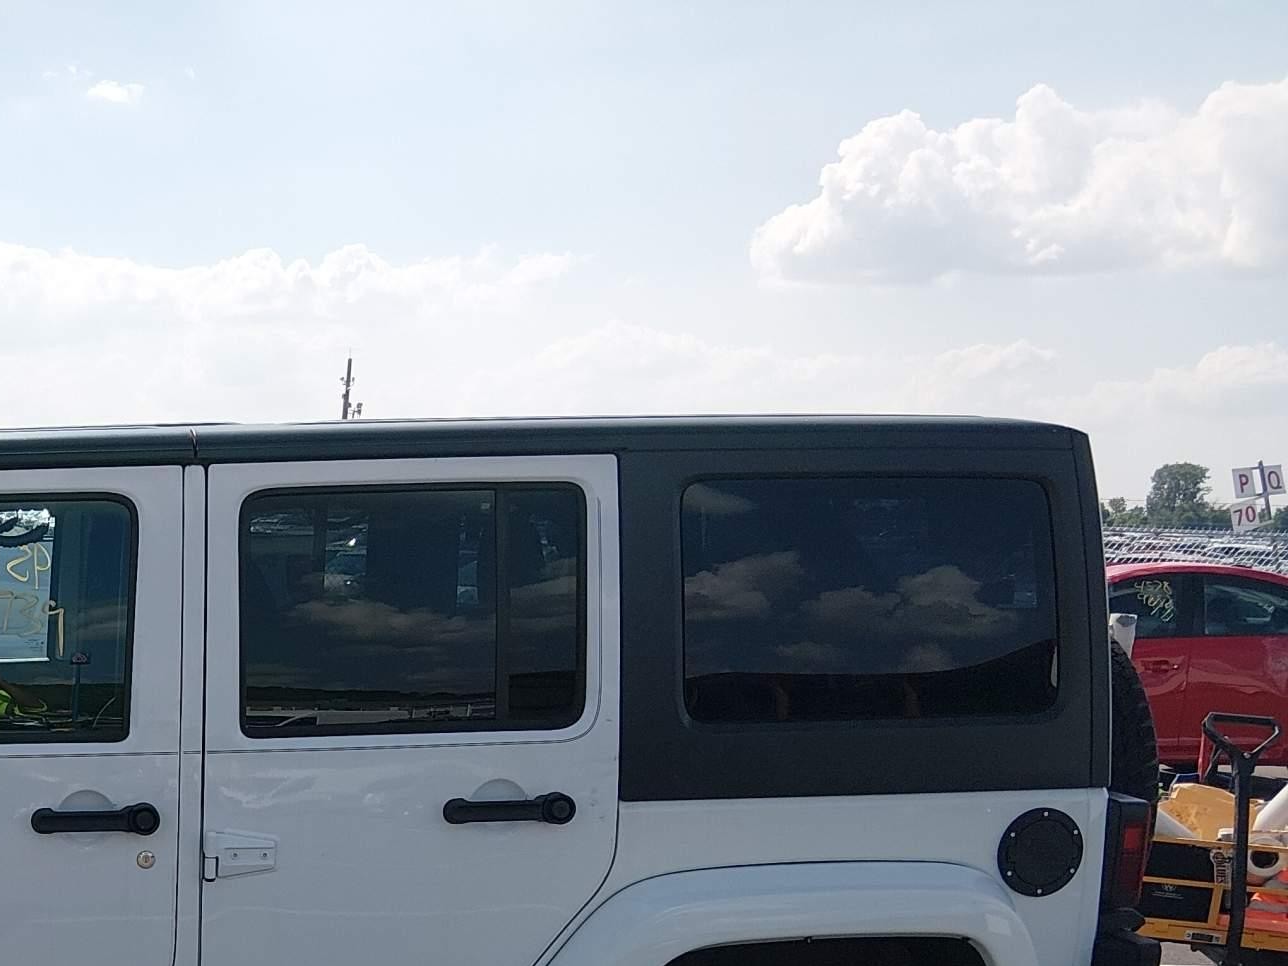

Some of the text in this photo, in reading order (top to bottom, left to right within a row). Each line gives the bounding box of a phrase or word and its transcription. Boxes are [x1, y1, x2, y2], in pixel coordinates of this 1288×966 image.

[1239, 474, 1249, 493] P
[1267, 470, 1283, 490] Q
[1233, 505, 1257, 526] 70
